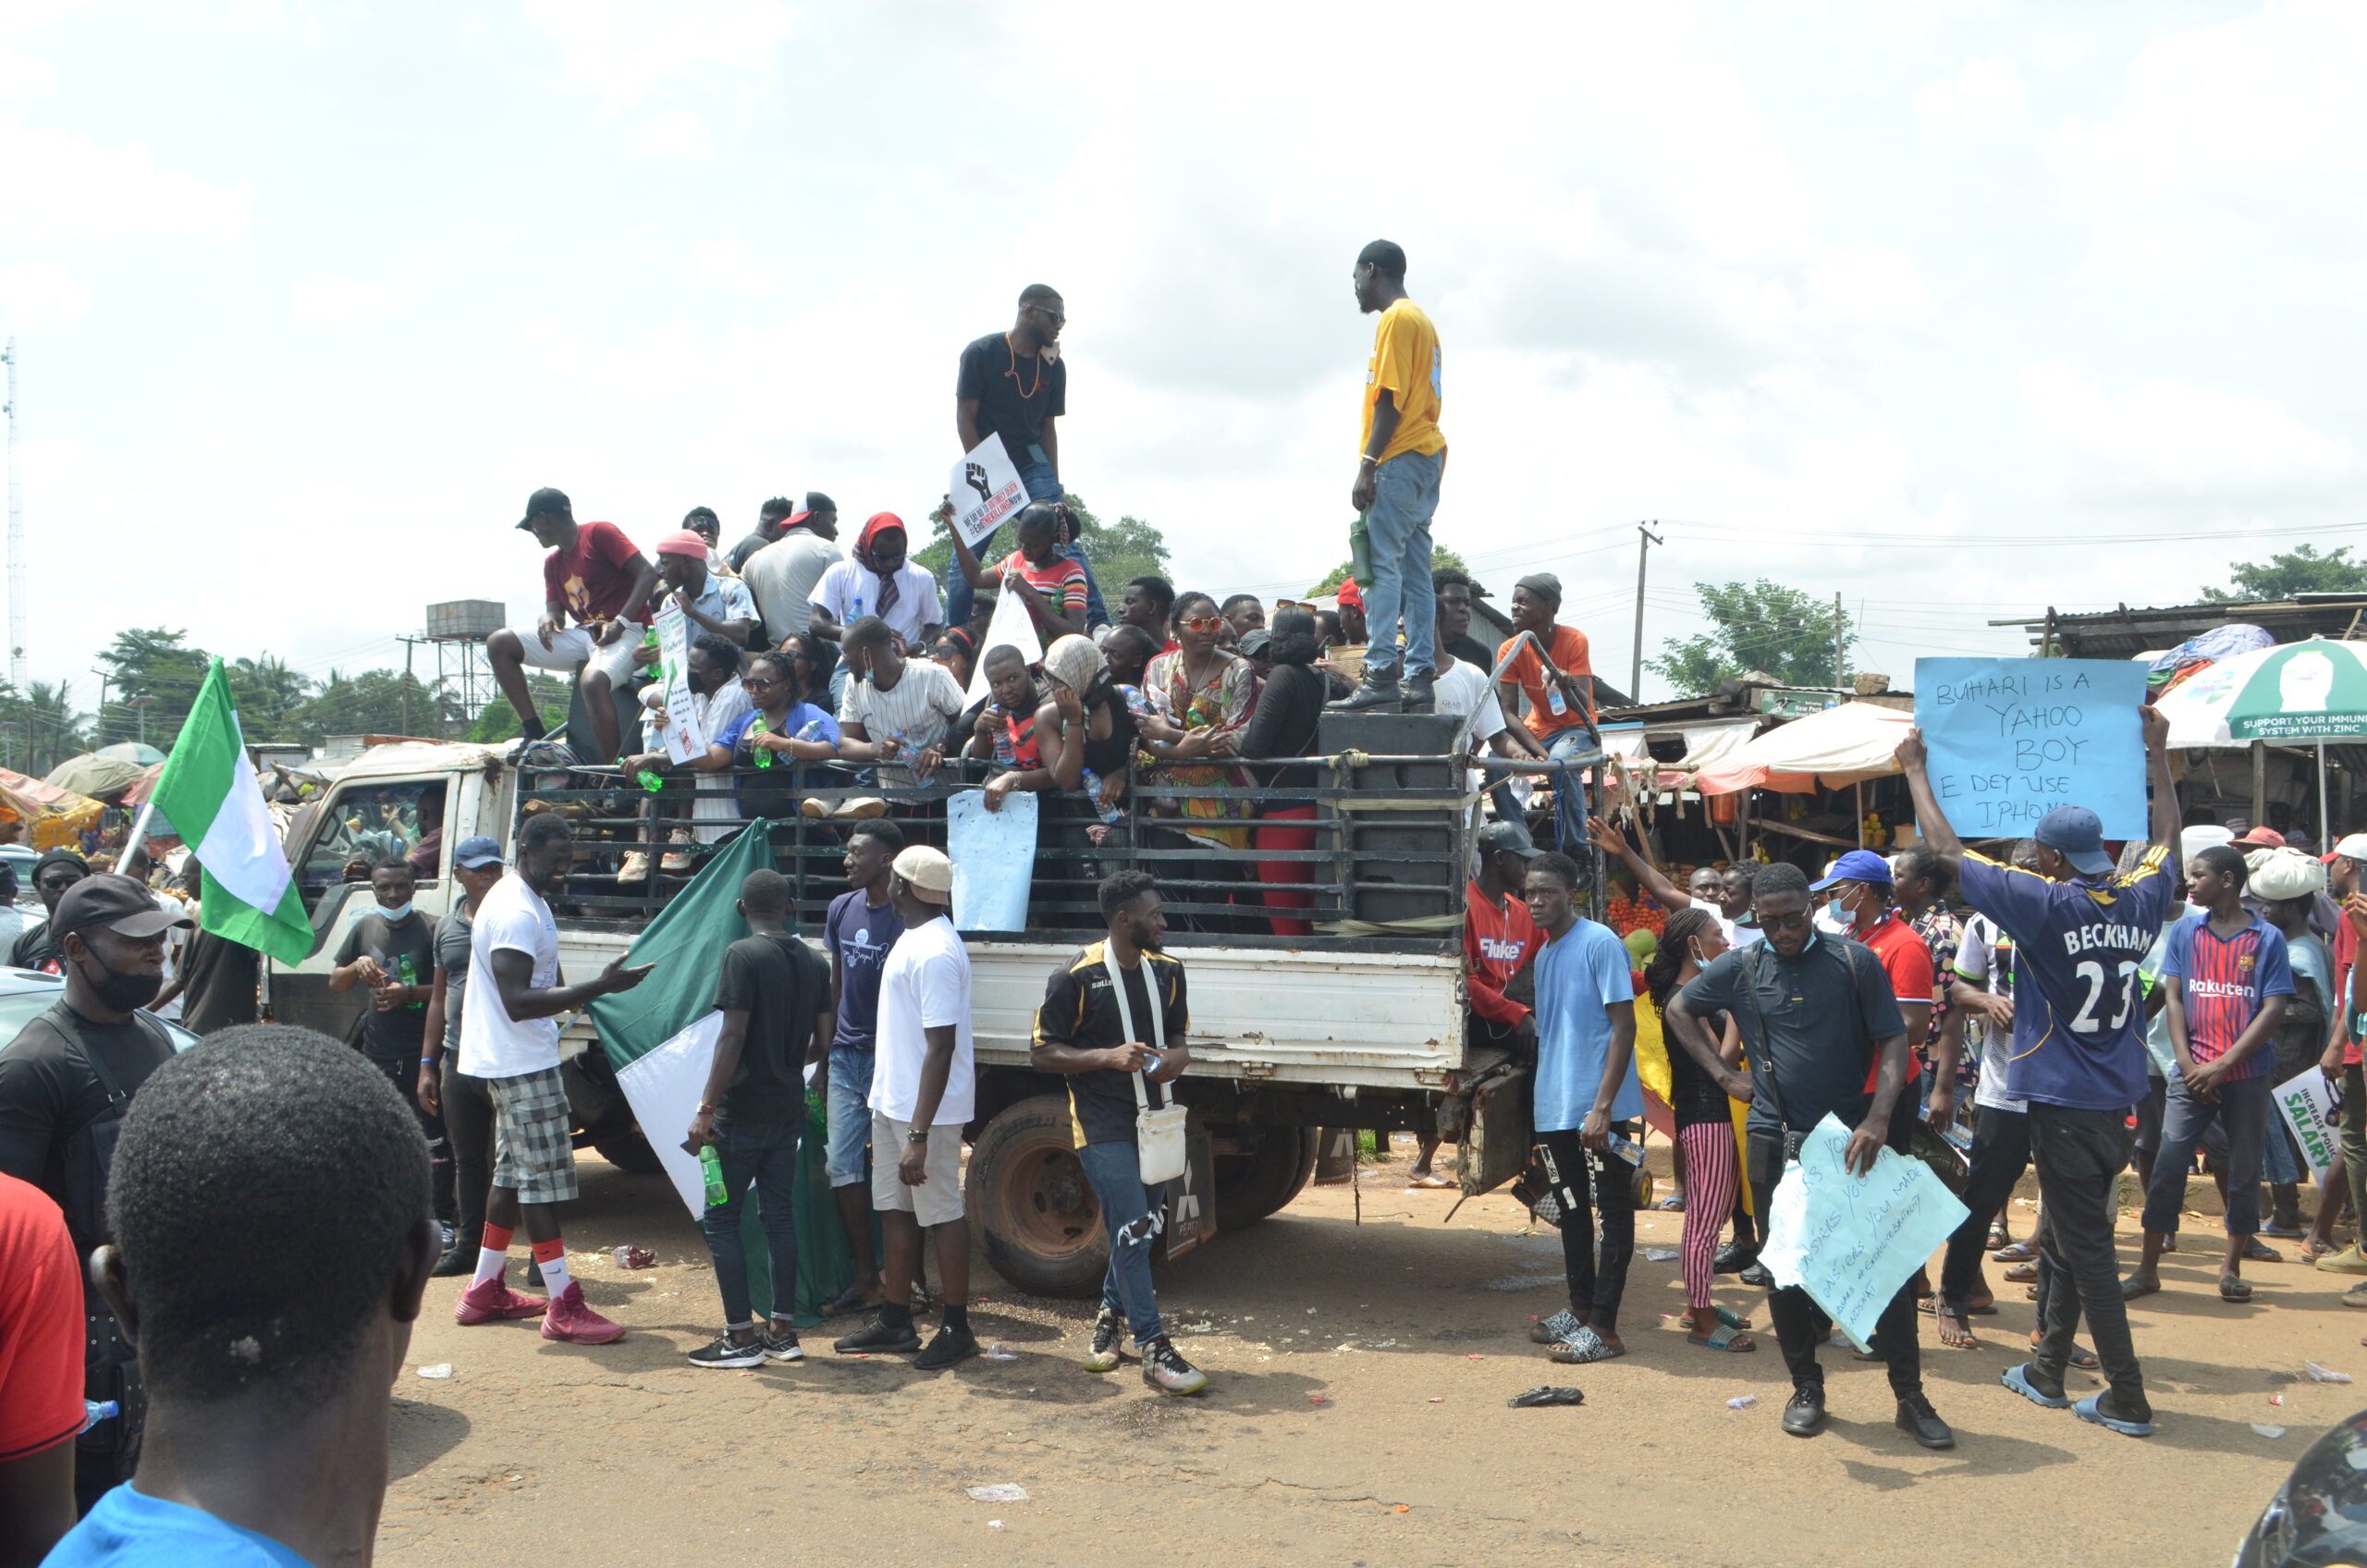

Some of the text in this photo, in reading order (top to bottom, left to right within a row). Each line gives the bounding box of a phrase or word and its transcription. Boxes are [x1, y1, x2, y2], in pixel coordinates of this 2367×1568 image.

[1937, 672, 2091, 705] BUHARI IS A
[1986, 703, 2082, 737] YAHOO
[2243, 714, 2367, 729] SUPPORT YOUR IMMUN
[2259, 724, 2361, 736] SYSTEM WITH ZINC
[2016, 736, 2089, 771] BOY
[1941, 775, 2071, 798] E DEY USE
[1479, 938, 1520, 959] Fluke
[2064, 924, 2153, 956] BECKHAM
[2069, 961, 2139, 1033] 23
[2189, 978, 2254, 998] Rakuten
[2284, 1093, 2332, 1168] SALARY
[2300, 1088, 2337, 1158] INCREASE POLIC
[1823, 1241, 1865, 1298] ONSTERS
[1866, 1199, 1892, 1240] YOU
[1893, 1167, 1922, 1196] MADE
